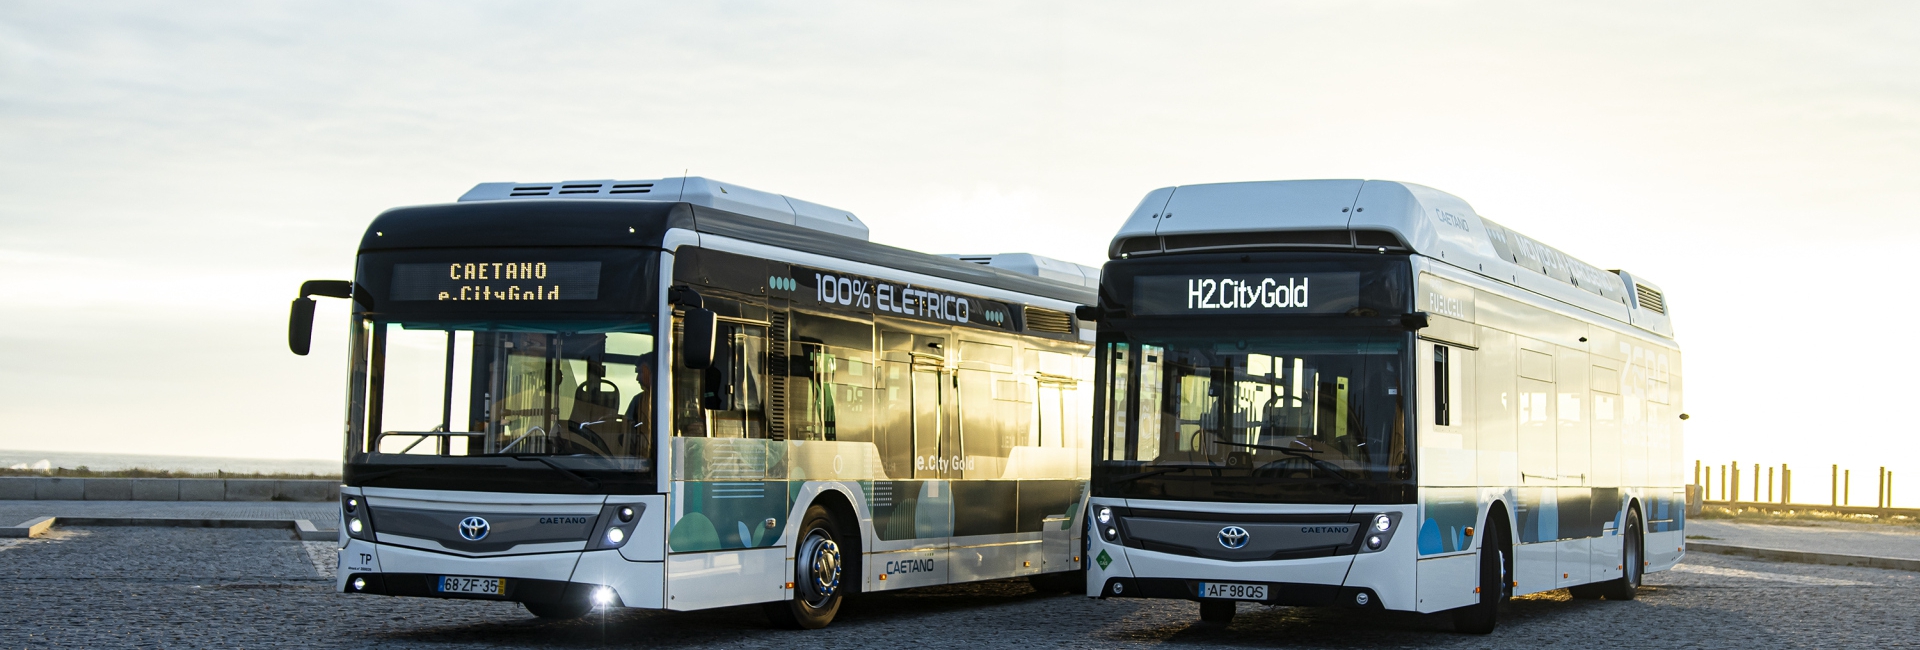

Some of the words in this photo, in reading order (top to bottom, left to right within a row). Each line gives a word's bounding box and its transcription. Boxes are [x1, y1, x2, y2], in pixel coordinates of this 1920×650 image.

[1436, 208, 1469, 232] CAETANO
[1514, 233, 1557, 269] MOVIDO
[450, 262, 547, 280] CAETANO
[816, 273, 871, 309] 100%
[877, 283, 969, 323] ELÉTRICO
[1188, 277, 1308, 299] H2.CityGold
[1620, 341, 1669, 404] ZERO
[951, 455, 975, 471] Gold
[539, 517, 587, 525] CAETANO
[359, 553, 372, 565] TP
[886, 558, 934, 575] CAETANO
